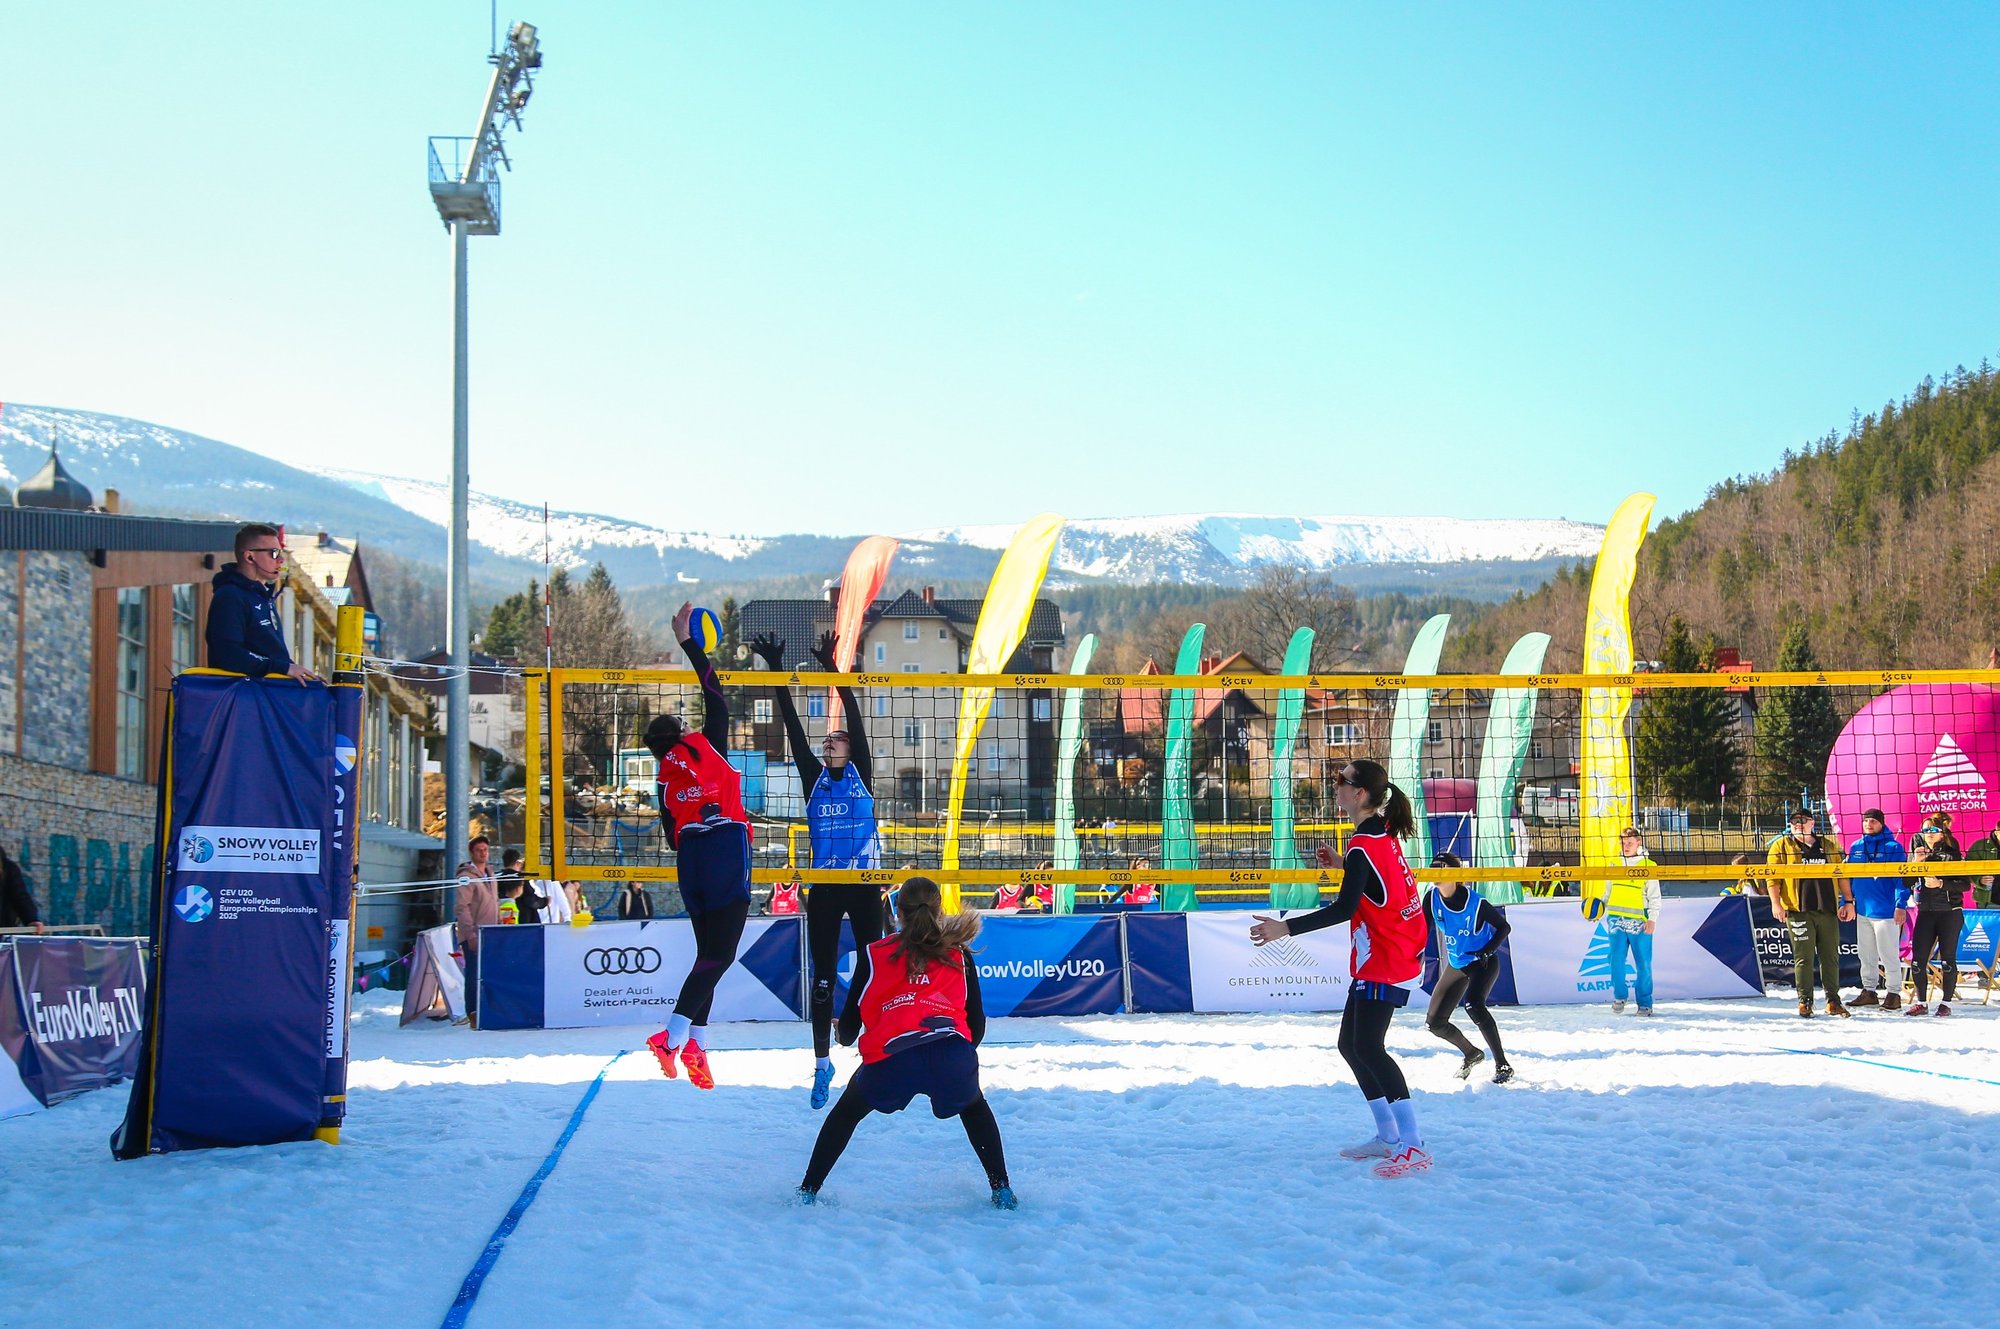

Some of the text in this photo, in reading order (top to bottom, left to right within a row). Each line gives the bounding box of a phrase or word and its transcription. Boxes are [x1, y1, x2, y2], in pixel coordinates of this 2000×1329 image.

[1540, 677, 1559, 685] CEV
[1742, 675, 1761, 683] CEV
[1894, 673, 1913, 681] CEV
[1917, 788, 1988, 803] KARPACZ
[1919, 801, 1987, 814] ZAWSZE GÓRĄ
[217, 837, 318, 851] SNOW VOLLEY
[252, 852, 304, 862] POLAND
[1758, 868, 1777, 876] CEV
[1911, 865, 1930, 873] CEV
[873, 873, 894, 881] CEV
[1033, 873, 1053, 881] CEV
[1242, 873, 1263, 881] CEV
[1553, 870, 1573, 878] CEV
[238, 889, 254, 897] U20
[219, 897, 281, 906] Snow Volleyball
[219, 905, 318, 915] European Championships
[218, 912, 238, 920] 2025
[1228, 975, 1342, 987] GREEN MOUNTAIN
[584, 986, 653, 997] Dealer Audi
[31, 986, 142, 1047] EuroVolley.TV
